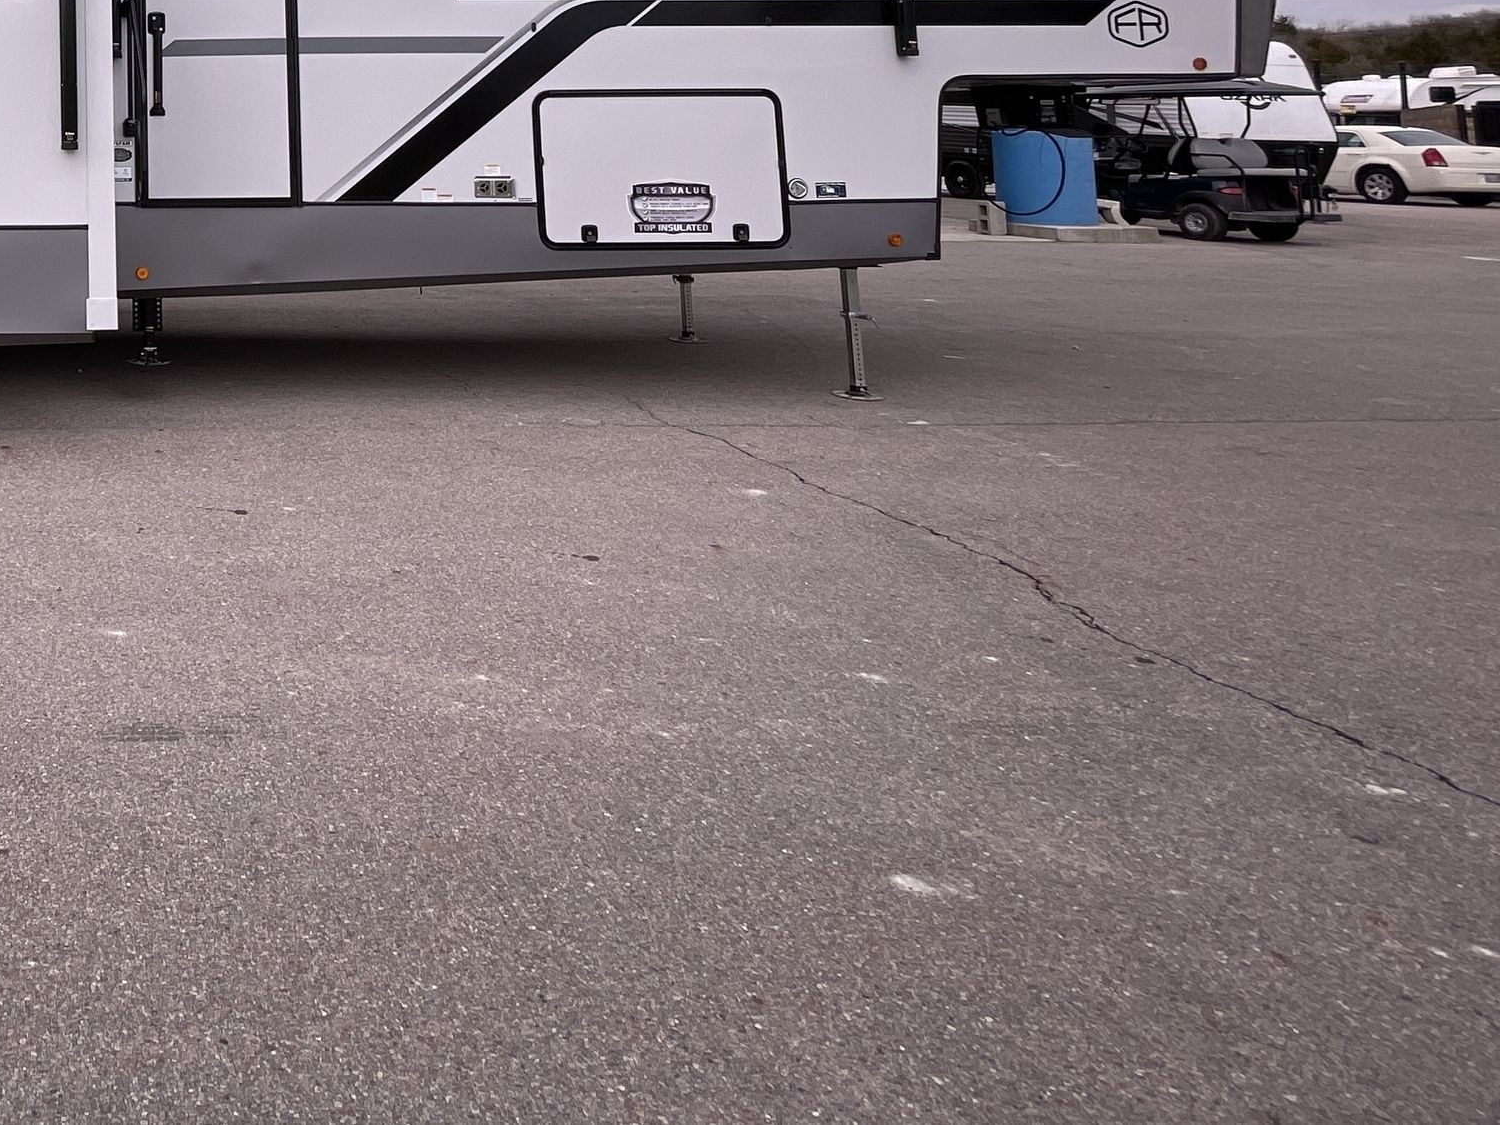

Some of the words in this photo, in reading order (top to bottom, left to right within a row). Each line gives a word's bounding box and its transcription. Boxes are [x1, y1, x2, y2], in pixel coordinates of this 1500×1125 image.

[635, 186, 665, 195] BEST
[669, 186, 708, 195] VALUE
[638, 223, 656, 232] TOP
[658, 223, 709, 232] INSULATED
